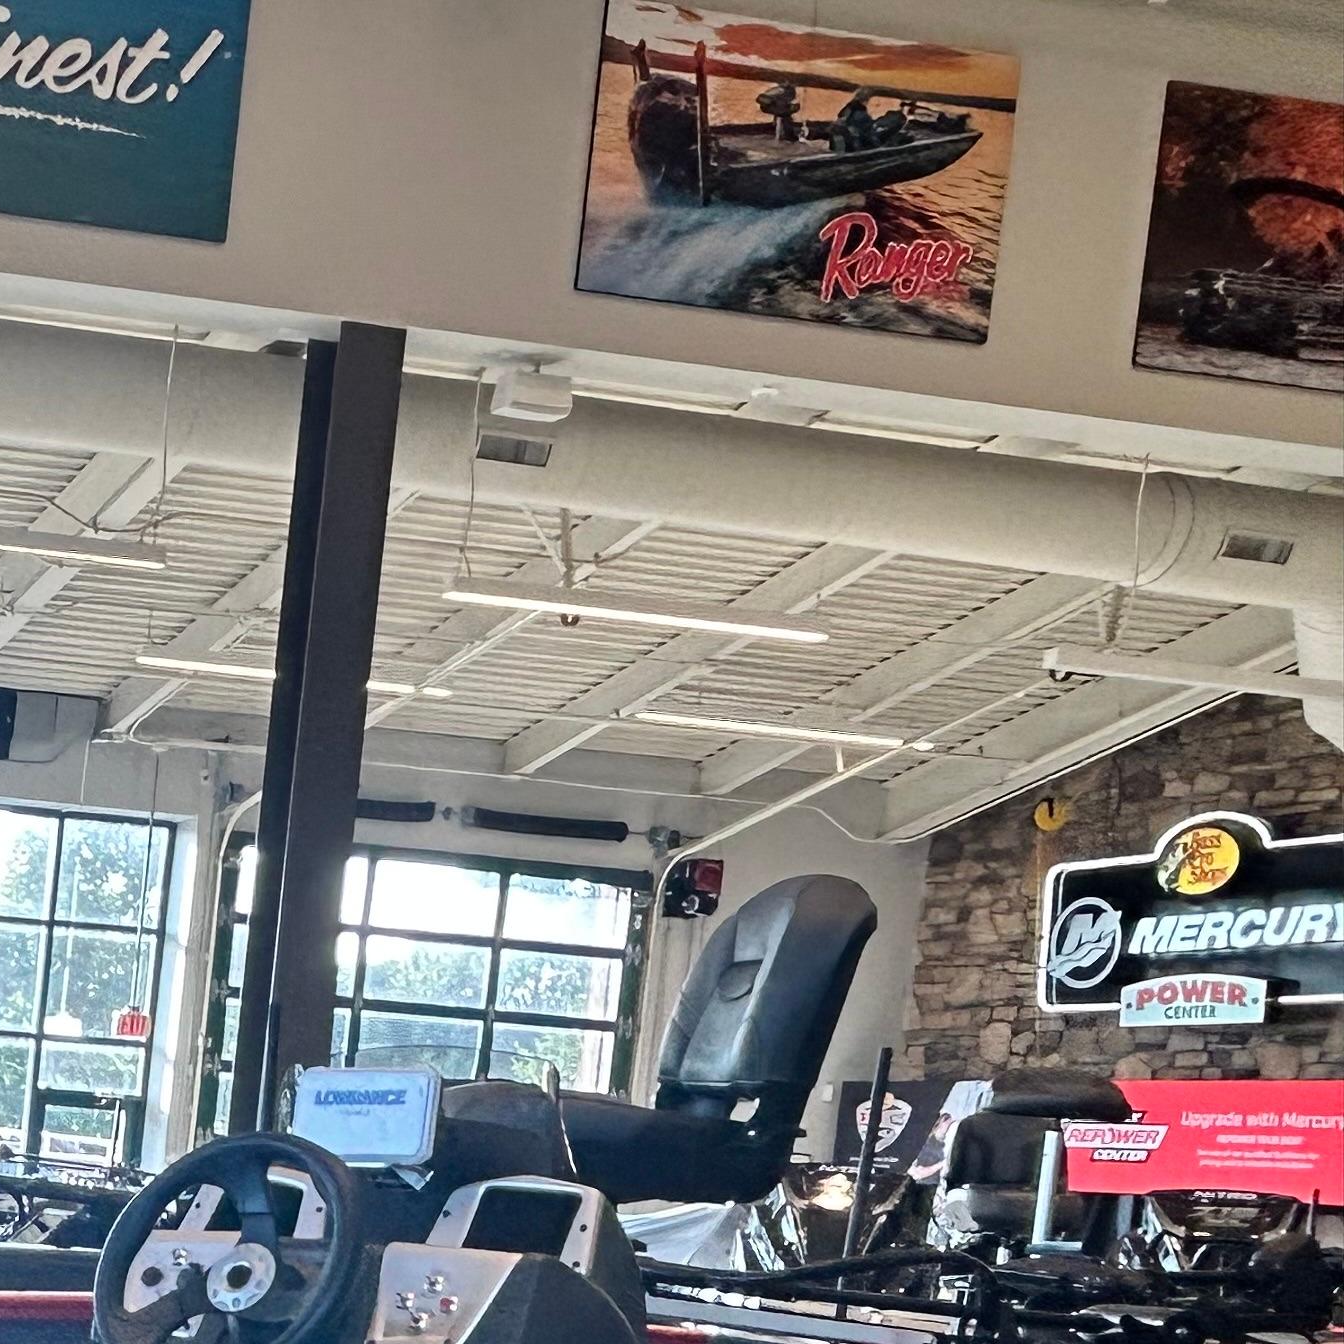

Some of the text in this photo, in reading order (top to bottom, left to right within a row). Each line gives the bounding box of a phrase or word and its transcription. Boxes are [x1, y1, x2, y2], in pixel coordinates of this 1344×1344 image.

[819, 212, 973, 303] Ranger
[1128, 902, 1344, 955] MERCUR
[1135, 980, 1247, 1010] POWER
[1164, 1005, 1217, 1019] CENTER
[1180, 1111, 1243, 1130] Upgrade
